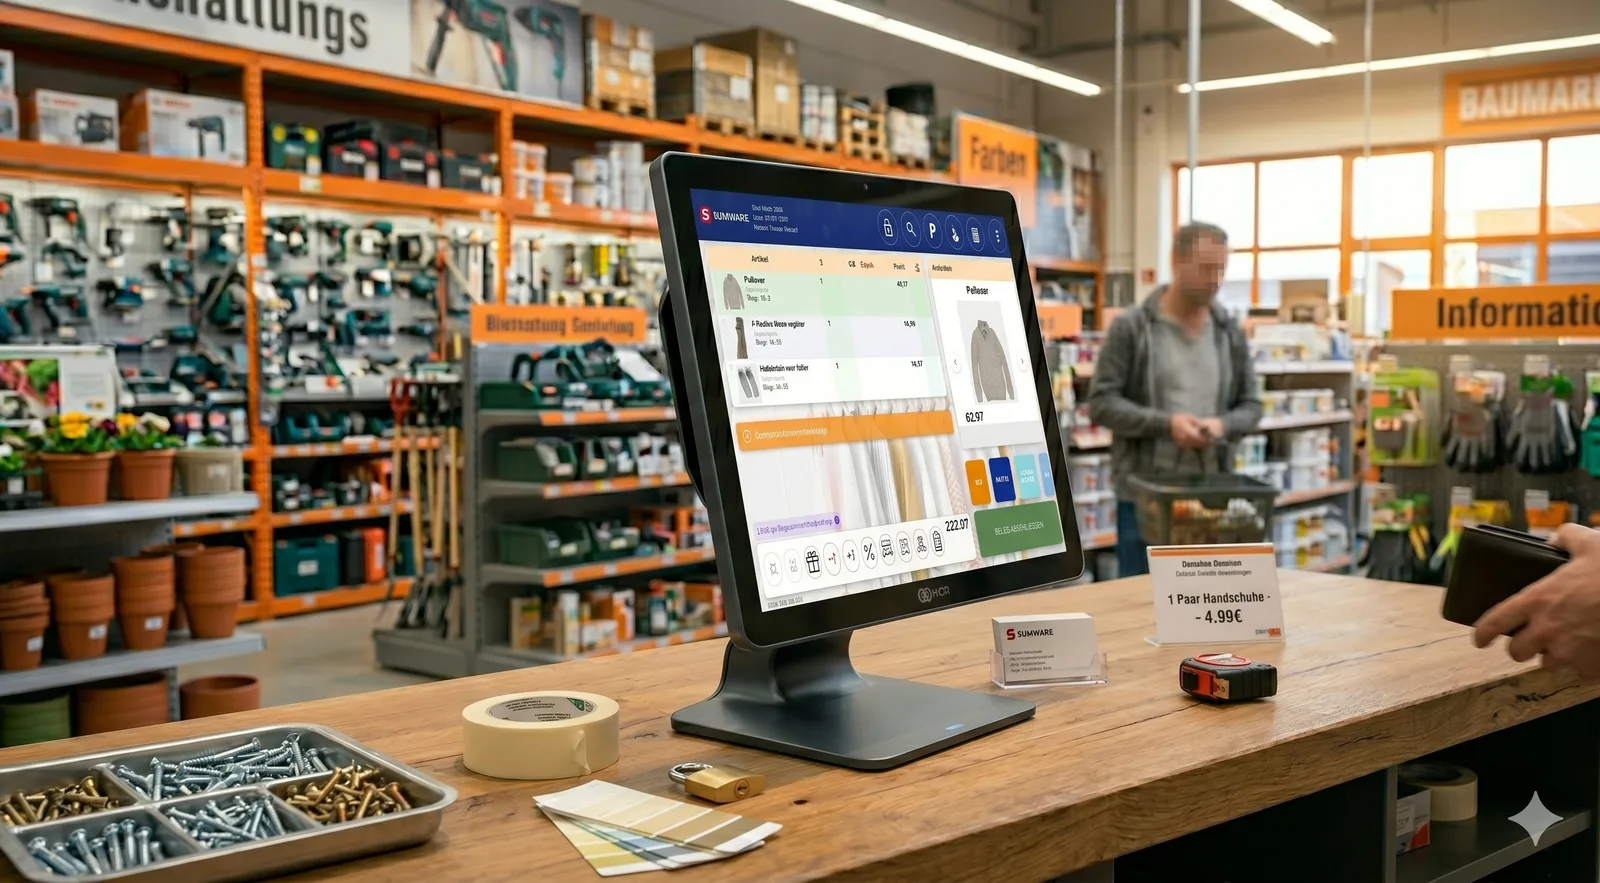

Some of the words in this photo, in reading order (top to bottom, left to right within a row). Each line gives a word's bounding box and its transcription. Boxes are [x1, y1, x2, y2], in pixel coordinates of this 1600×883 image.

[969, 133, 1028, 177] Farben
[751, 255, 769, 263] Artikel
[744, 276, 765, 284] Pullover
[1168, 594, 1173, 605] 1
[1177, 594, 1200, 604] Paar
[1203, 592, 1264, 604] Handschuhe
[1204, 609, 1243, 623] 4.99€
[1017, 629, 1053, 637] SUMWARE
